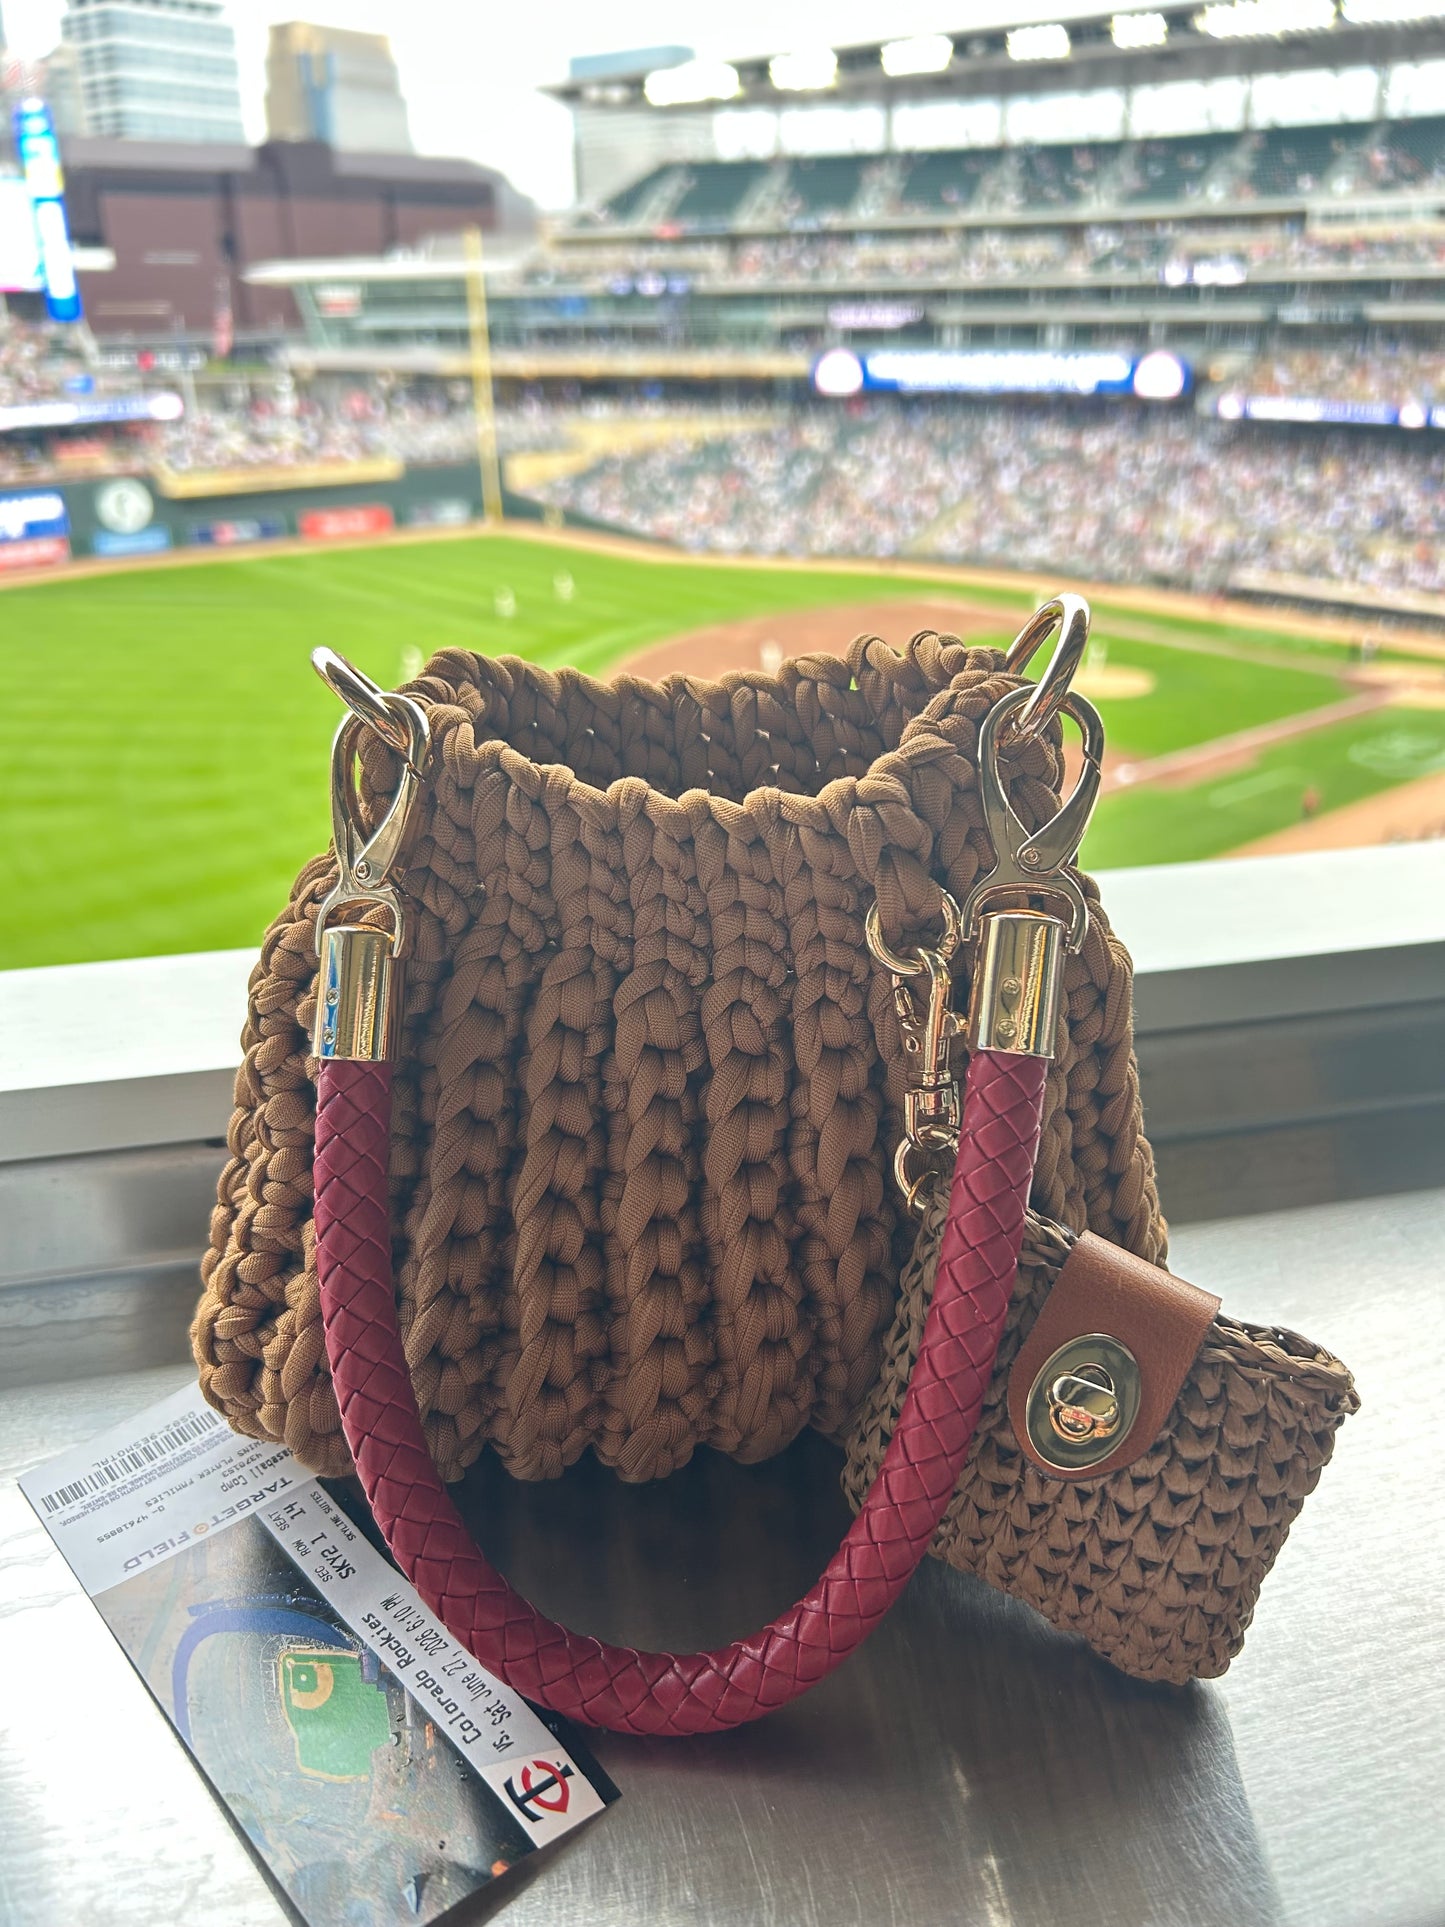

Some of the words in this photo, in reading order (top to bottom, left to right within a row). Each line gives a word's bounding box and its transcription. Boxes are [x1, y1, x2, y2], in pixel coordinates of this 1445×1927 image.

[196, 1455, 234, 1480] PLAYER
[120, 1482, 144, 1496] FORTH
[144, 1477, 194, 1508] FAMILIES
[219, 1473, 248, 1494] Comp
[80, 1489, 116, 1511] RE-ENTRY.
[89, 1499, 110, 1512] BACK
[211, 1474, 294, 1526] TARGET
[282, 1500, 307, 1522] 14
[308, 1489, 334, 1516] SUITES
[59, 1509, 90, 1527] HEREOF.
[266, 1508, 290, 1532] SEAT
[328, 1512, 357, 1543] SKYLINE
[121, 1530, 190, 1573] FIELD
[292, 1538, 312, 1558] ROW
[310, 1530, 328, 1546] 1
[314, 1564, 333, 1583] SEC
[320, 1543, 357, 1580] SKY2
[379, 1591, 405, 1612] PM
[392, 1604, 426, 1634] 6:10
[360, 1610, 416, 1670] Rockies
[413, 1626, 450, 1658] 2026
[438, 1649, 468, 1678] 27,
[458, 1670, 493, 1704] June
[412, 1667, 483, 1745] Colorado
[482, 1698, 513, 1726] Sat
